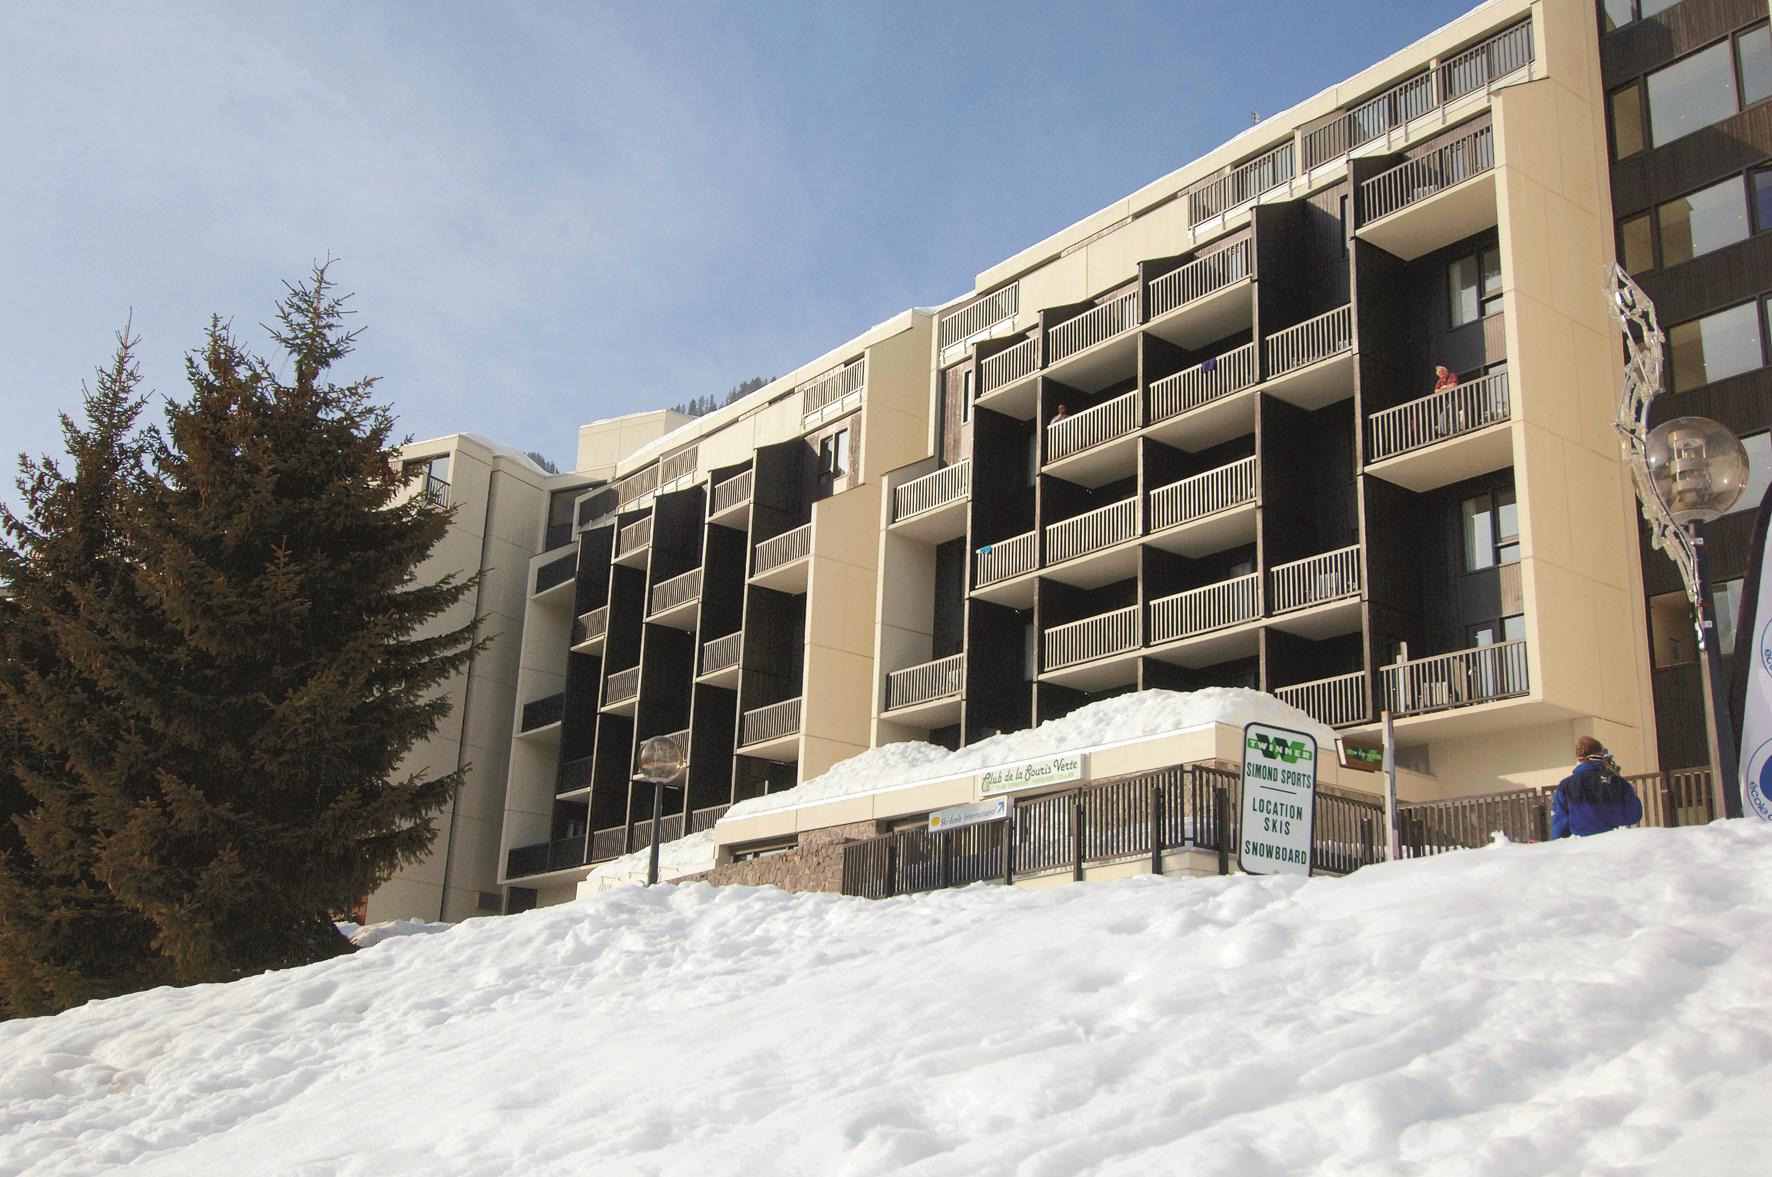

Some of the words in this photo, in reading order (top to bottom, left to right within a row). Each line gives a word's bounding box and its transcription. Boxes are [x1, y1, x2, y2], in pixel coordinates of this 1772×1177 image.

[1249, 738, 1312, 760] TWINNER
[982, 772, 1002, 792] Club
[1004, 770, 1014, 782] de
[1015, 768, 1023, 779] la
[1024, 763, 1052, 781] Souris
[1053, 758, 1078, 772] Verte
[1246, 762, 1278, 782] SIMOND
[1281, 769, 1311, 789] SPORTS
[1252, 797, 1303, 820] LOCATION
[1264, 817, 1290, 835] SKIS
[1245, 840, 1307, 865] SNOWBOARD
